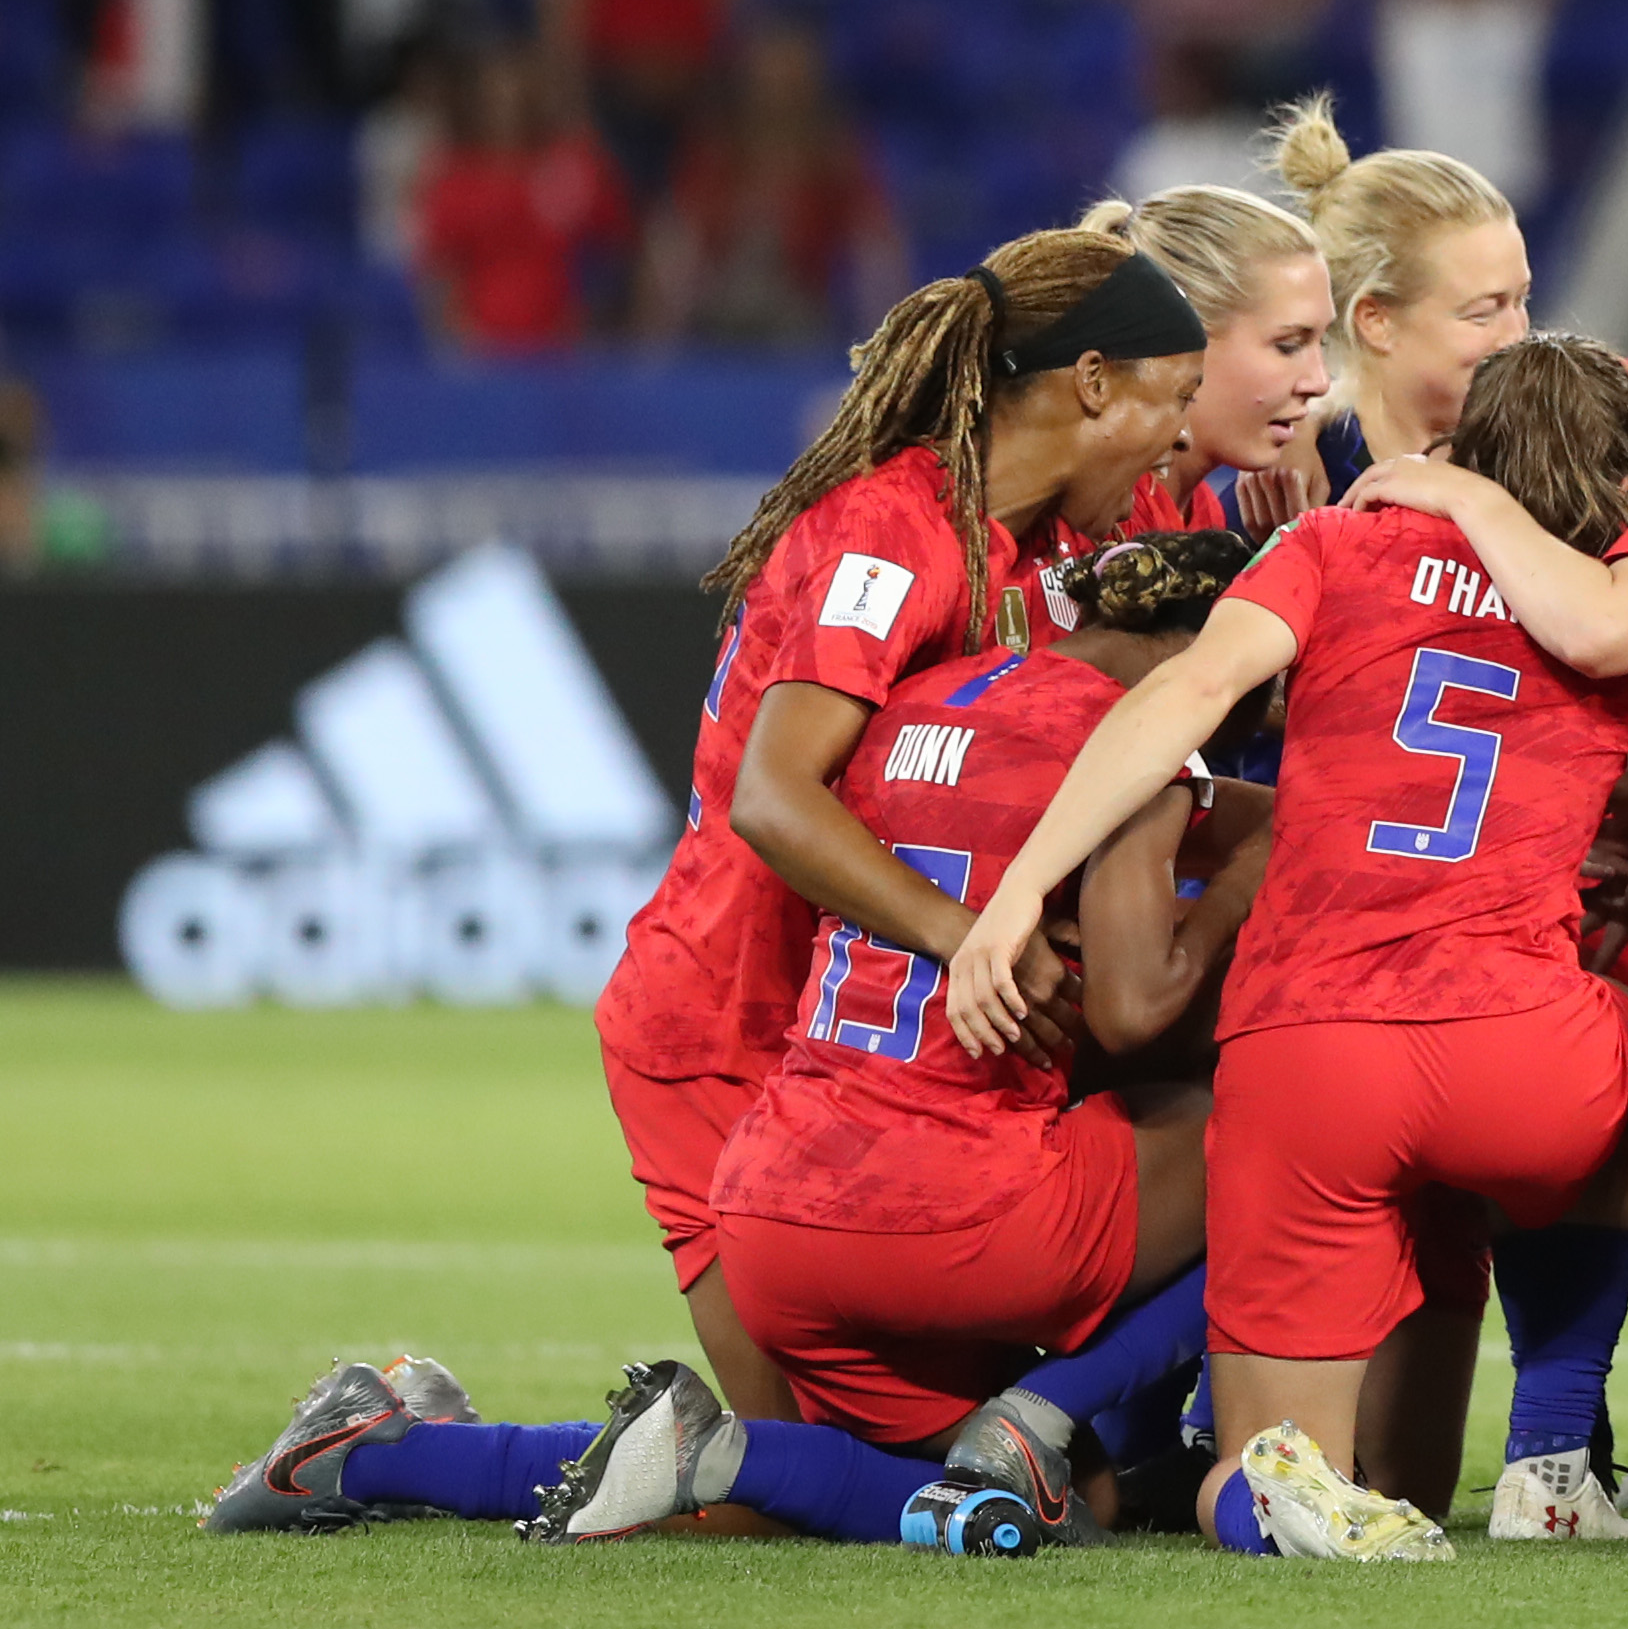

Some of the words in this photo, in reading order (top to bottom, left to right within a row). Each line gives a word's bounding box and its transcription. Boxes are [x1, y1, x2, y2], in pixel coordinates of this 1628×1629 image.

[1410, 555, 1520, 625] O'HA
[884, 724, 975, 786] DUNN
[1366, 647, 1521, 862] 5
[118, 848, 662, 1012] adida
